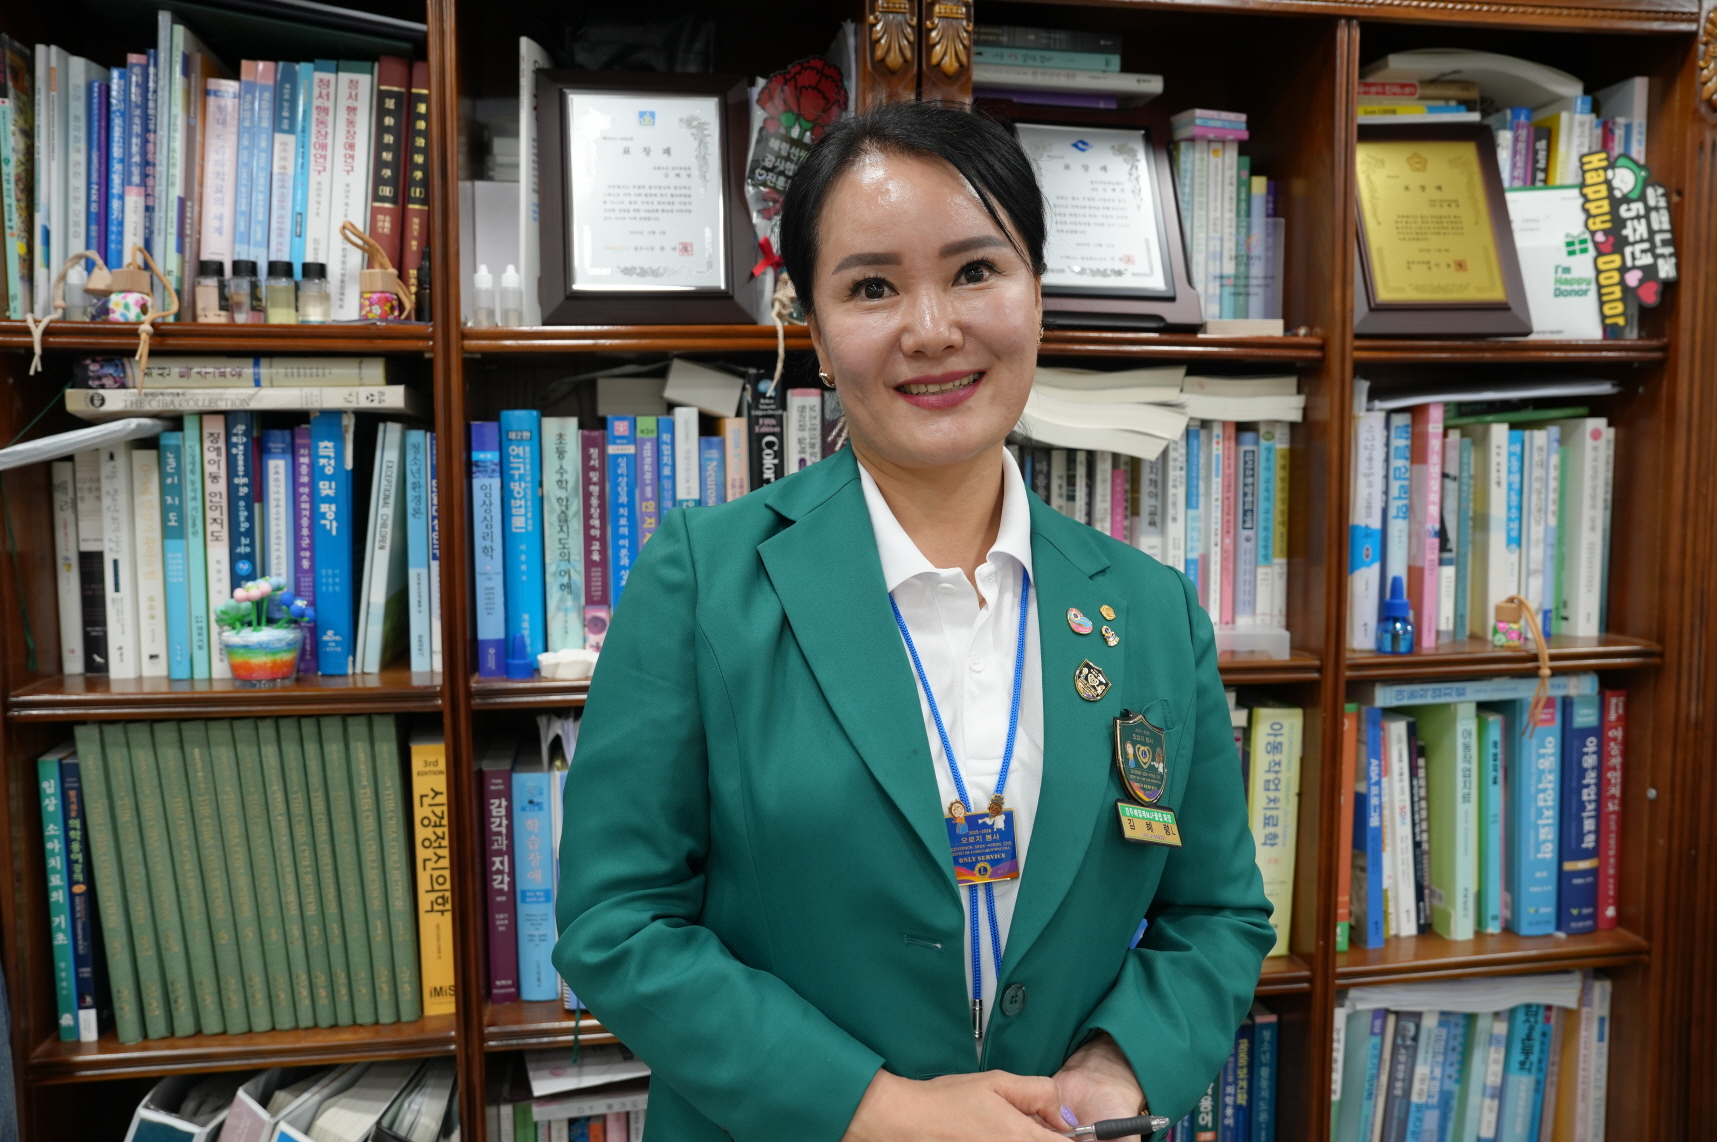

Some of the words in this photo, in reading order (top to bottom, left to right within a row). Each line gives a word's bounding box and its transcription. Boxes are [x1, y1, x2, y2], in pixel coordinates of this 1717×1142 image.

[313, 78, 331, 176] 정서·행동장애연구
[343, 79, 359, 176] 정서·행동장애연구
[1580, 152, 1613, 231] Happy
[1618, 201, 1655, 268] 5주년
[1645, 185, 1678, 279] 생명나눔
[1554, 265, 1571, 275] I'm
[1554, 275, 1592, 287] Happy
[1553, 287, 1591, 298] Donor
[1595, 253, 1626, 327] Donor
[178, 365, 243, 379] 특수교육
[122, 398, 146, 409] THE
[148, 398, 178, 408] CIBA
[179, 396, 252, 408] COLLECTION
[755, 425, 781, 433] Edition
[166, 451, 180, 484] 놀이
[206, 431, 222, 484] 장애아동
[318, 440, 336, 475] 측정
[762, 435, 779, 483] Color
[1393, 423, 1411, 525] 발달심리학
[319, 481, 336, 497] 및
[382, 460, 394, 509] EXCEPTIONAL
[167, 496, 182, 527] 지도
[208, 491, 225, 542] 인지지도
[319, 503, 338, 536] 평가
[480, 483, 495, 560] 임상심리학
[378, 513, 388, 550] CHILDREN
[416, 769, 445, 777] EDITION
[423, 758, 439, 768] 3rd
[1369, 758, 1380, 783] ABA
[42, 779, 58, 812] 임상
[1262, 721, 1284, 847] 아동작업치료학
[1537, 736, 1555, 861] 아동작업치료학
[1581, 736, 1598, 849] 아동작업치료학
[489, 797, 508, 852] 감각과
[1127, 818, 1136, 830] 김
[1369, 784, 1380, 827] 프로그램
[420, 787, 451, 917] 신경정신의학
[525, 817, 543, 884] 학습장애
[961, 836, 982, 844] 오로지
[978, 852, 1006, 861] SERVICE
[45, 823, 65, 905] 소아치료의
[491, 854, 510, 892] 지각
[52, 914, 69, 946] 기초
